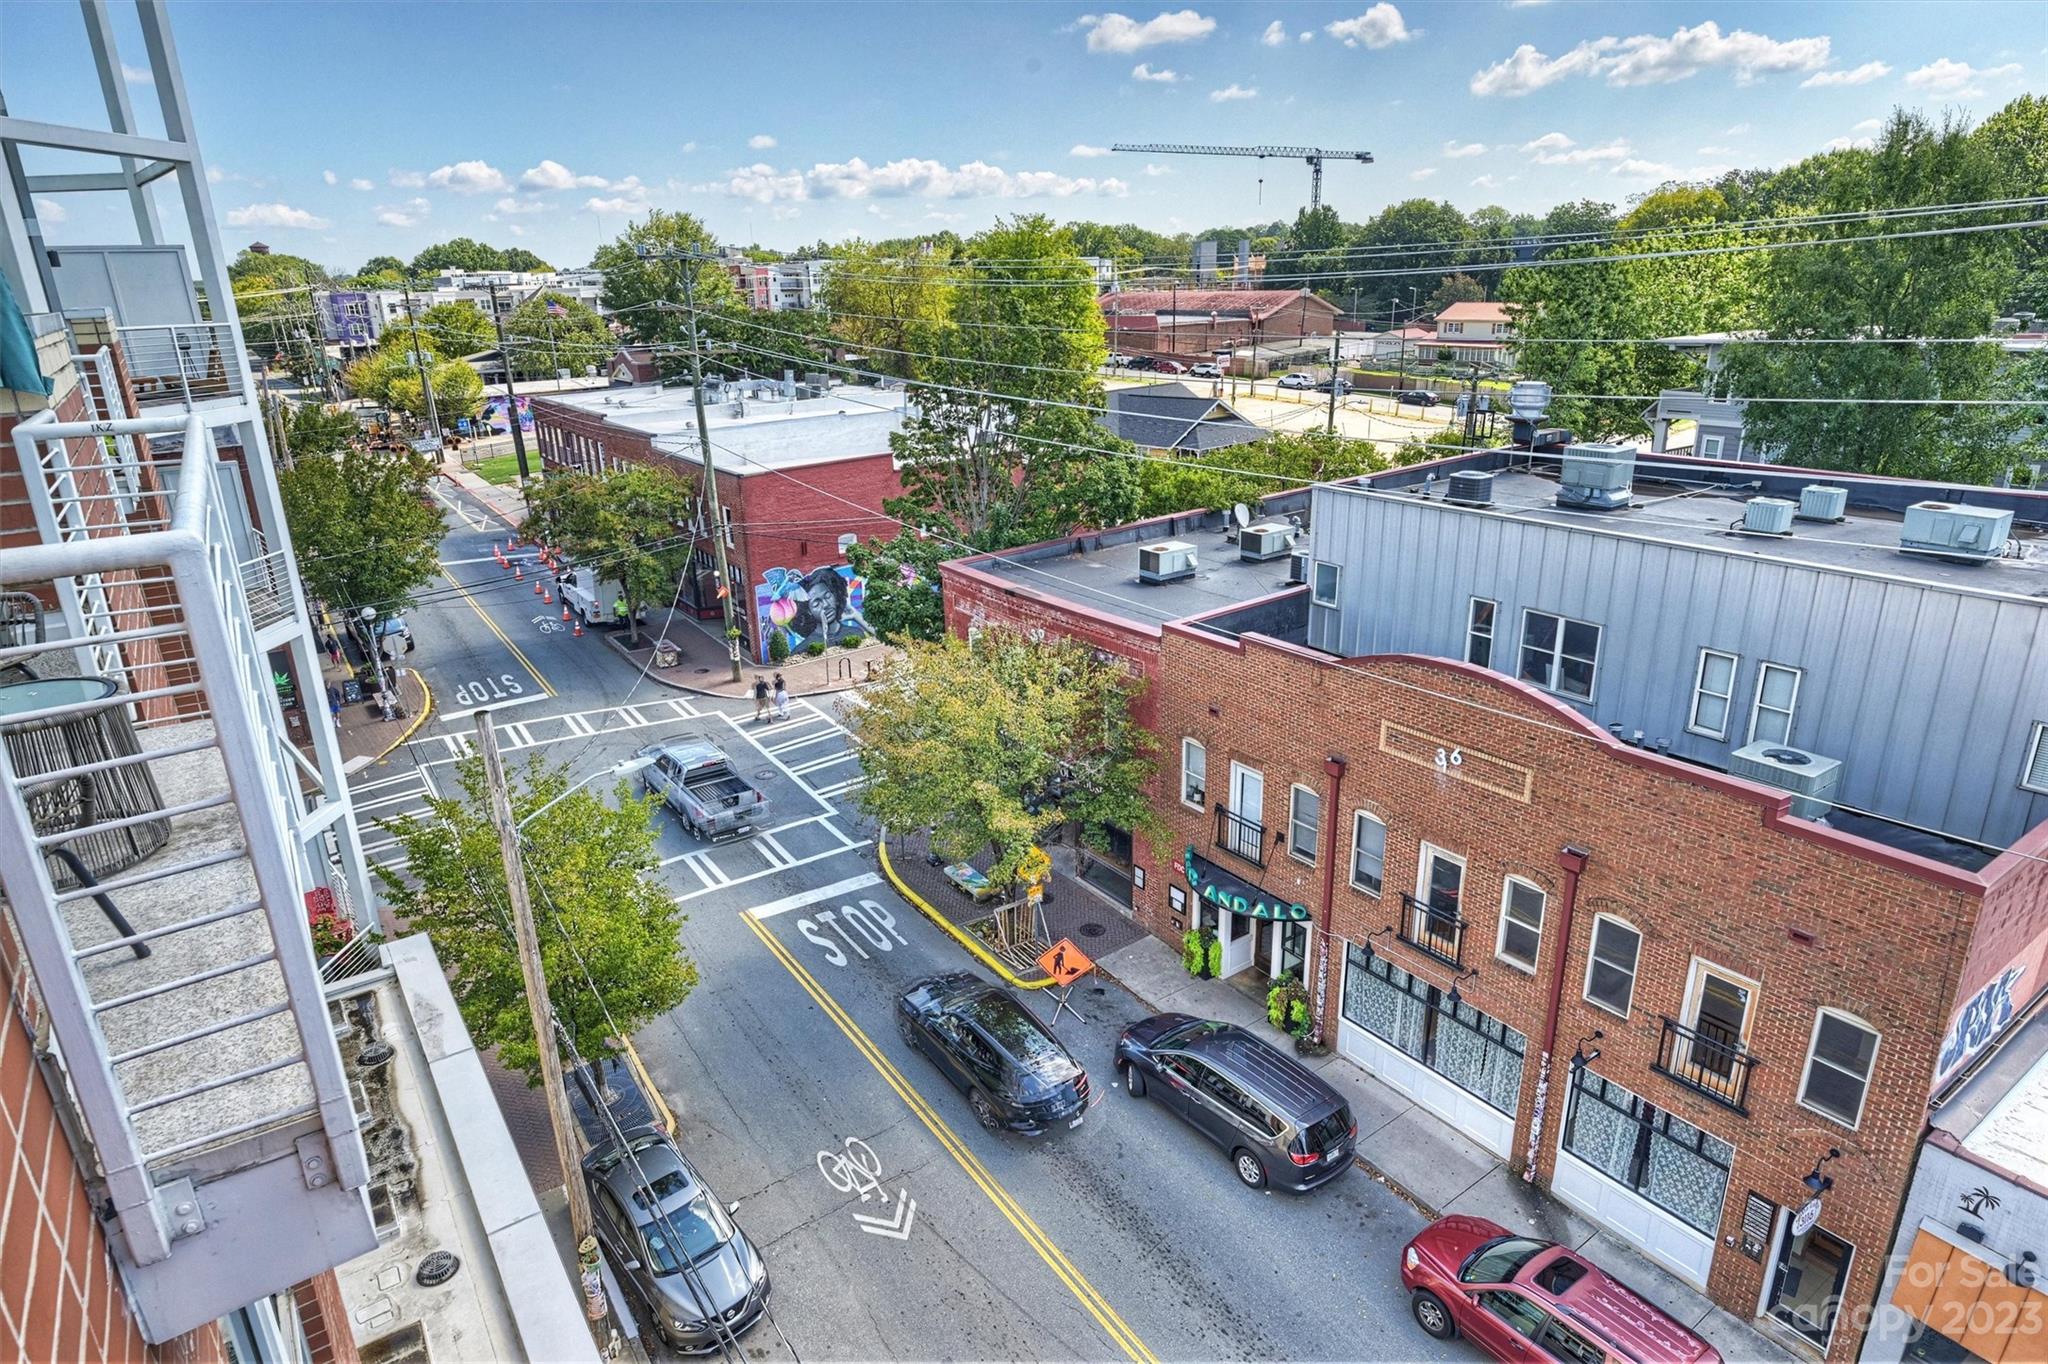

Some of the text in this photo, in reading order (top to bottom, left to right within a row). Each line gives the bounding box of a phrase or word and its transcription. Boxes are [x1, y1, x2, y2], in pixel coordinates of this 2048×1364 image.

[456, 674, 523, 705] STOP
[1435, 747, 1463, 768] 36
[1203, 885, 1308, 920] ANDALO
[797, 899, 909, 967] STOP
